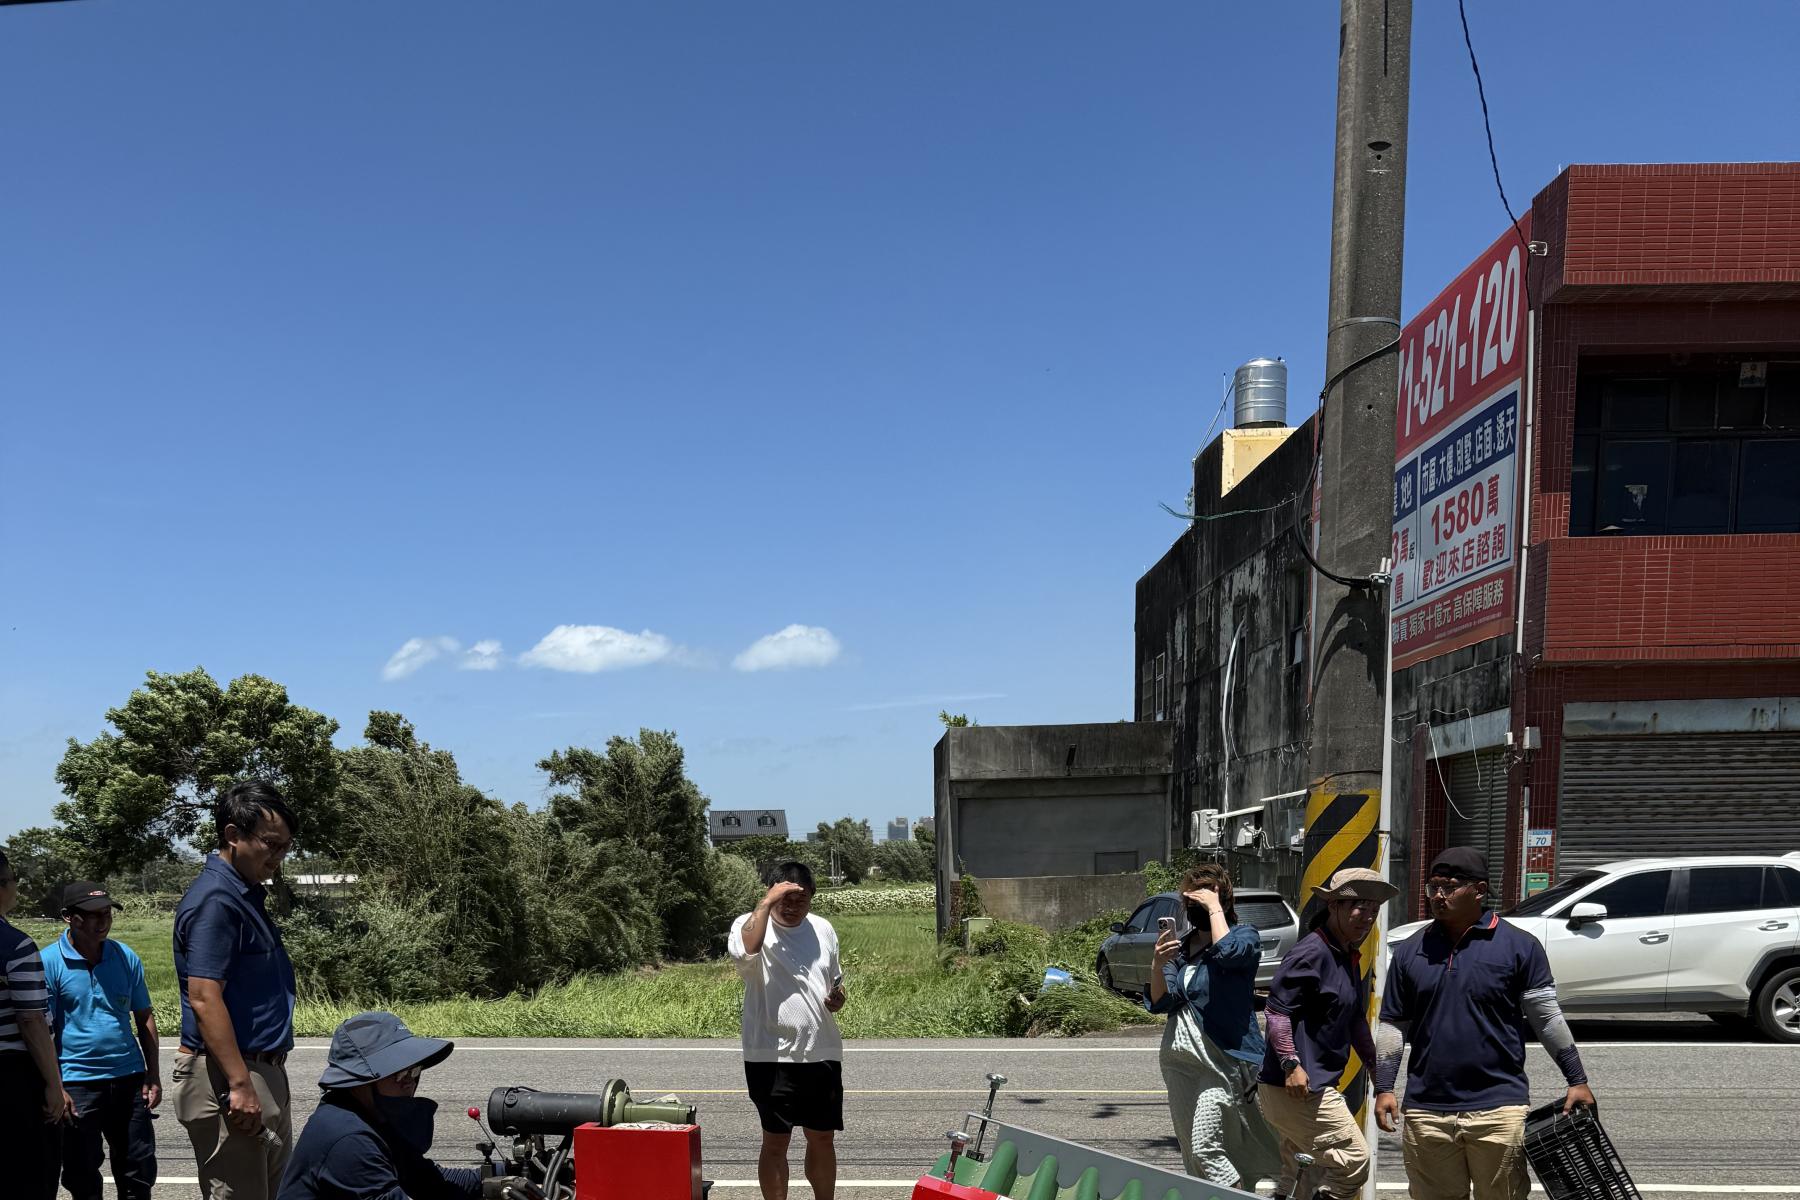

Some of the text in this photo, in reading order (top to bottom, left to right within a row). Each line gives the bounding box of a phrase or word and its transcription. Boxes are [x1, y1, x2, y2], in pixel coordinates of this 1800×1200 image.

[1432, 474, 1500, 546] 1580萬
[1422, 523, 1506, 591] 歡迎來店諮詢
[1453, 578, 1505, 622] 高保障服務
[1535, 837, 1547, 846] 70
